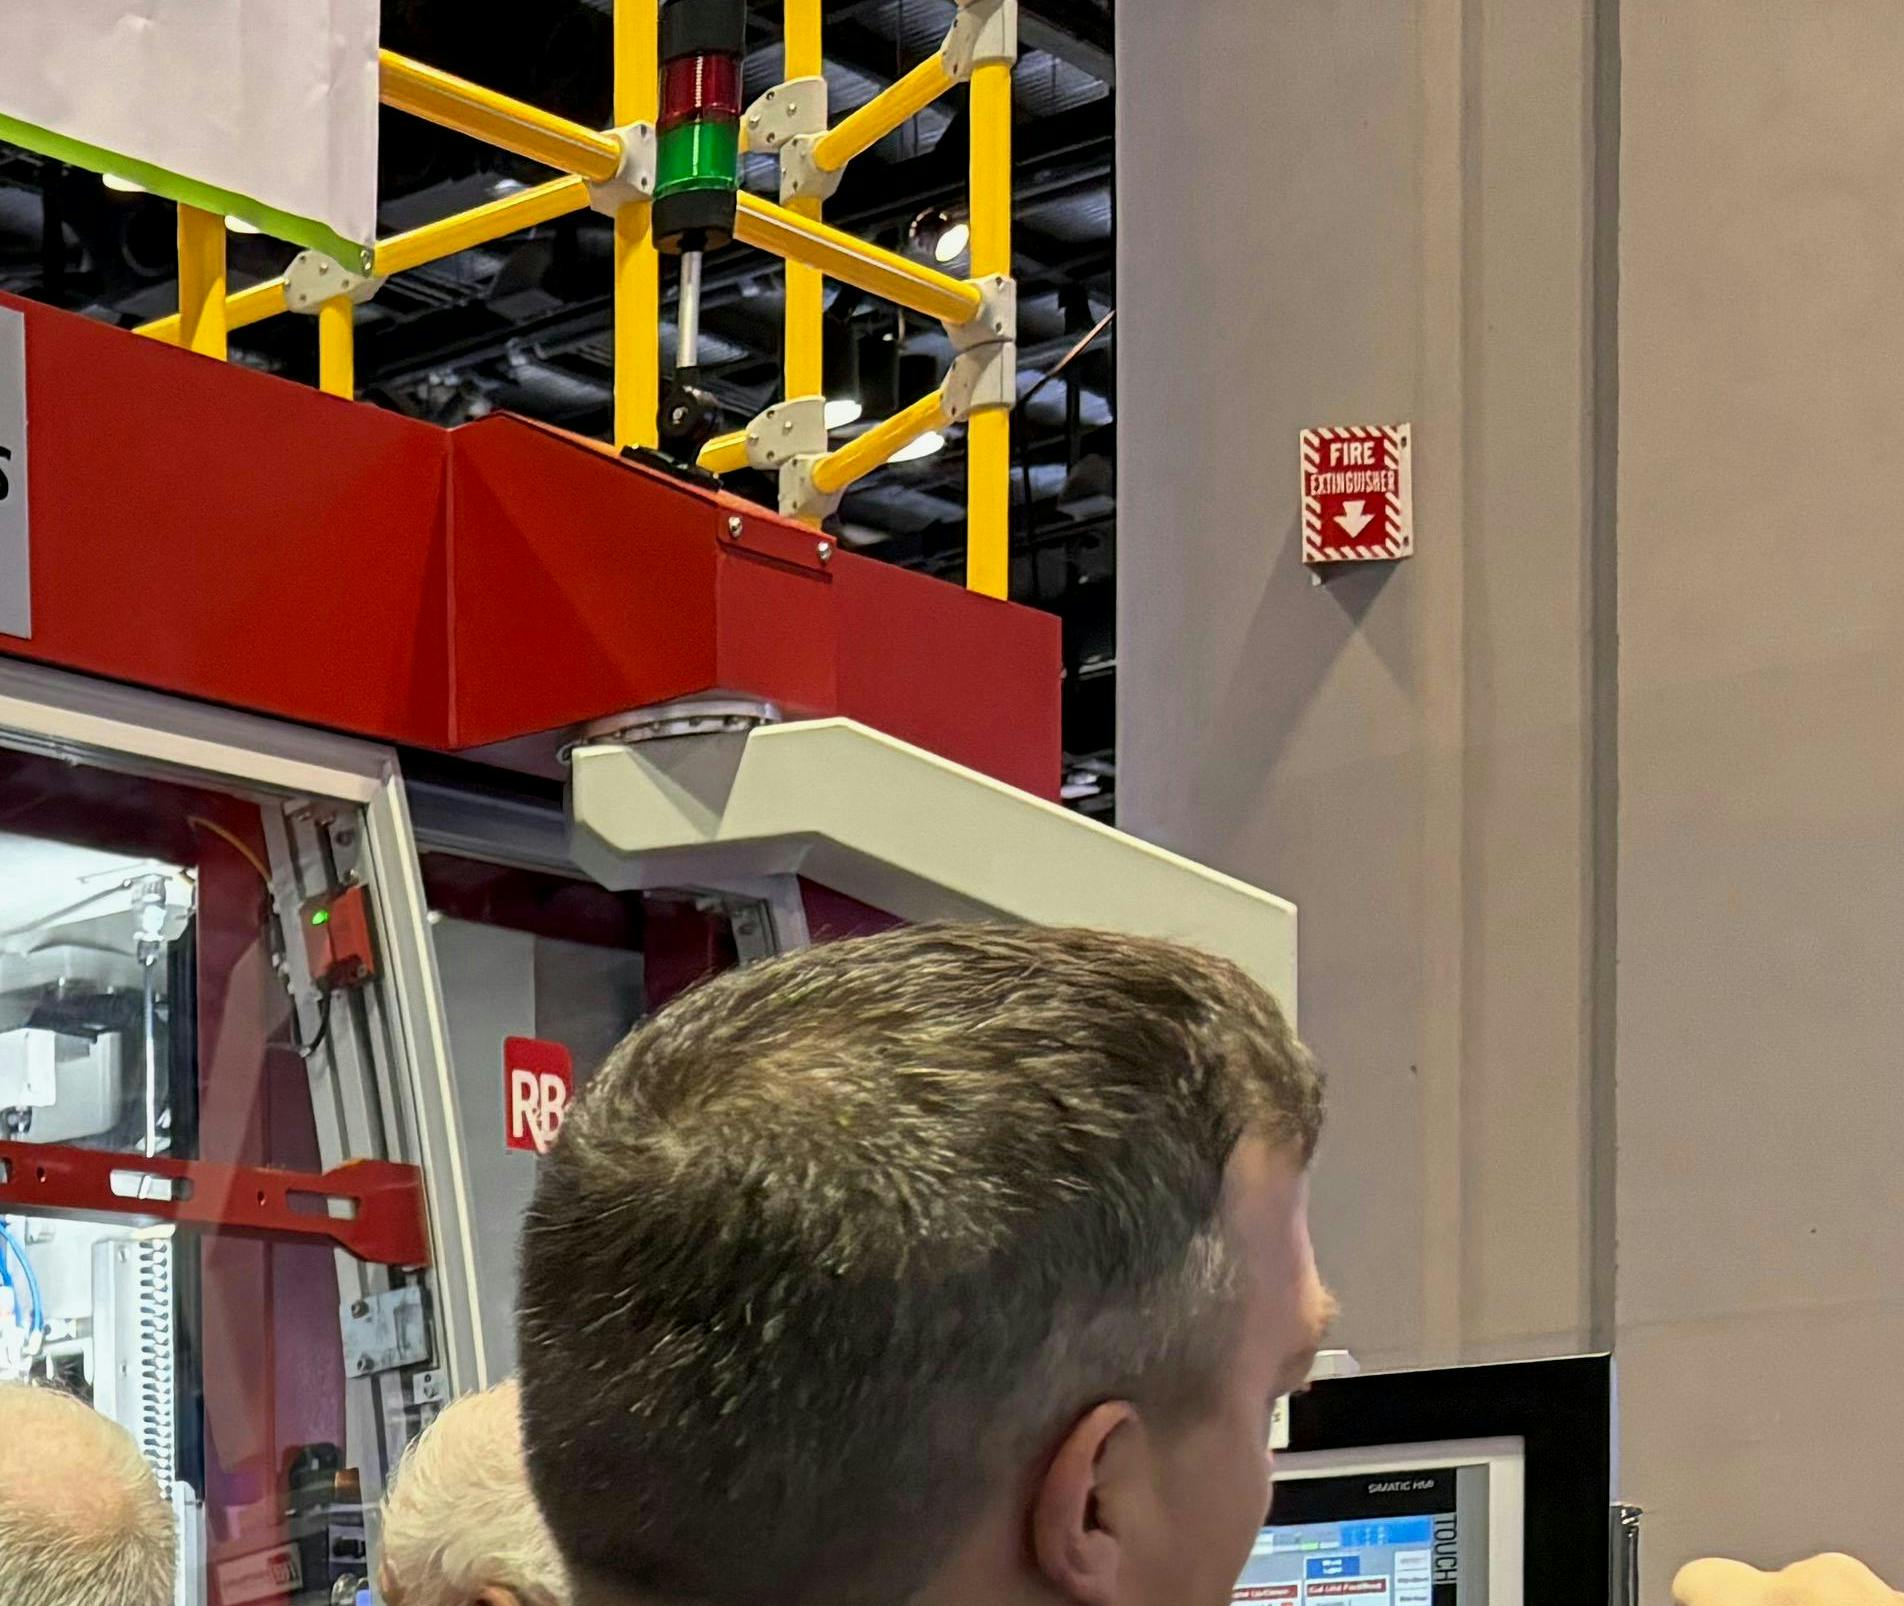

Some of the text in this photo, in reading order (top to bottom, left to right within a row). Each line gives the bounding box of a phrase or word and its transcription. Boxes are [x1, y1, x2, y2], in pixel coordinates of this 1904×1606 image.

[1330, 441, 1376, 466] FIRE
[1310, 470, 1395, 496] EXTINGUISHER
[1433, 1515, 1457, 1582] TOUCH
